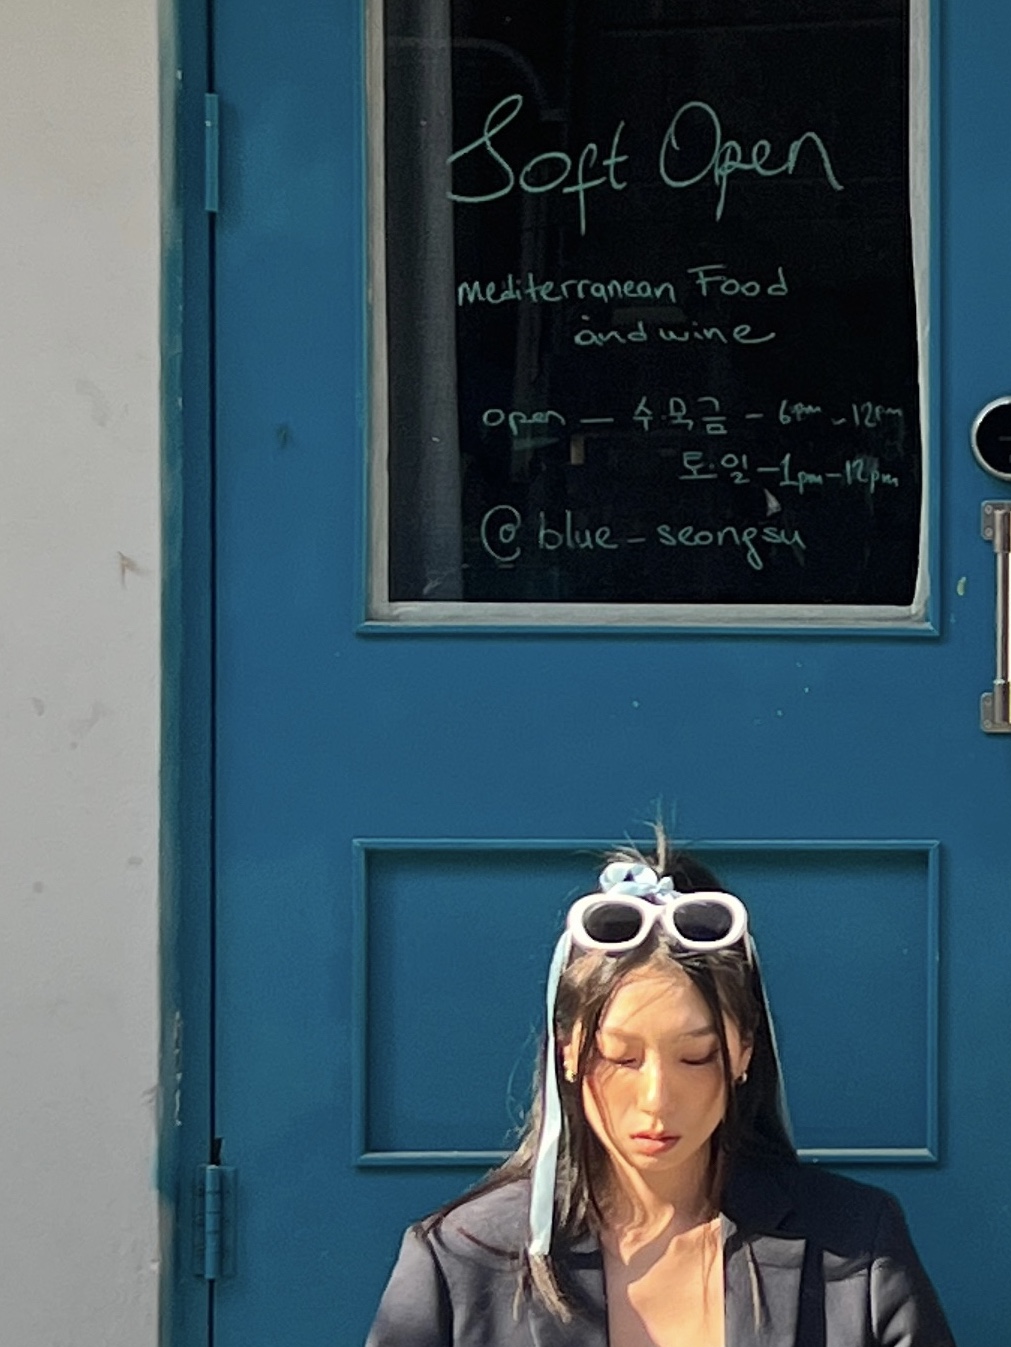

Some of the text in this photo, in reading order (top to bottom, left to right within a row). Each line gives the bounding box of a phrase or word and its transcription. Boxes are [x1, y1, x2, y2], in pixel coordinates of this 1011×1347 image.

[446, 94, 844, 236] Soft Open
[687, 264, 789, 297] Food
[659, 322, 776, 344] wine
